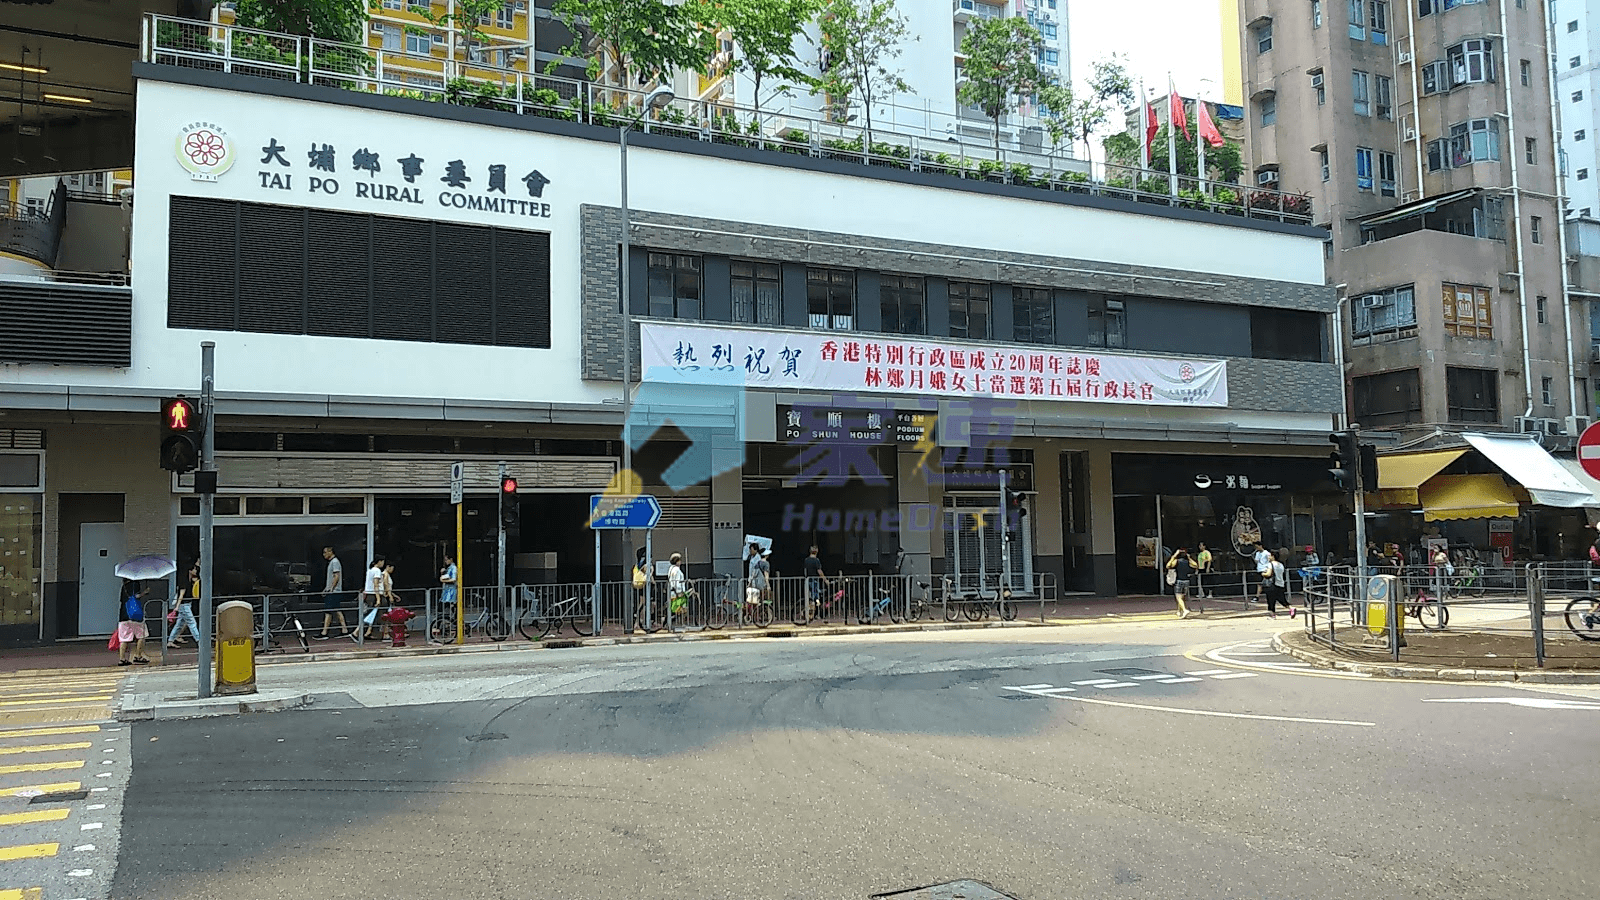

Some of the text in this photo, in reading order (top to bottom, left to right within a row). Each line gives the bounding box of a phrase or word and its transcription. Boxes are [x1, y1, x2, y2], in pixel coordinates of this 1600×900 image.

[260, 138, 550, 198] 大埔鄉事委員會
[259, 171, 551, 218] TAI PO RURAL COMMITTEE
[672, 341, 802, 378] 熱烈祝賀
[820, 340, 1101, 377] 香港特別行政區成立20周年誌慶
[786, 410, 882, 430] 寶順樓
[786, 430, 882, 440] PO SHUN HOUSE
[896, 434, 925, 442] FLOORS
